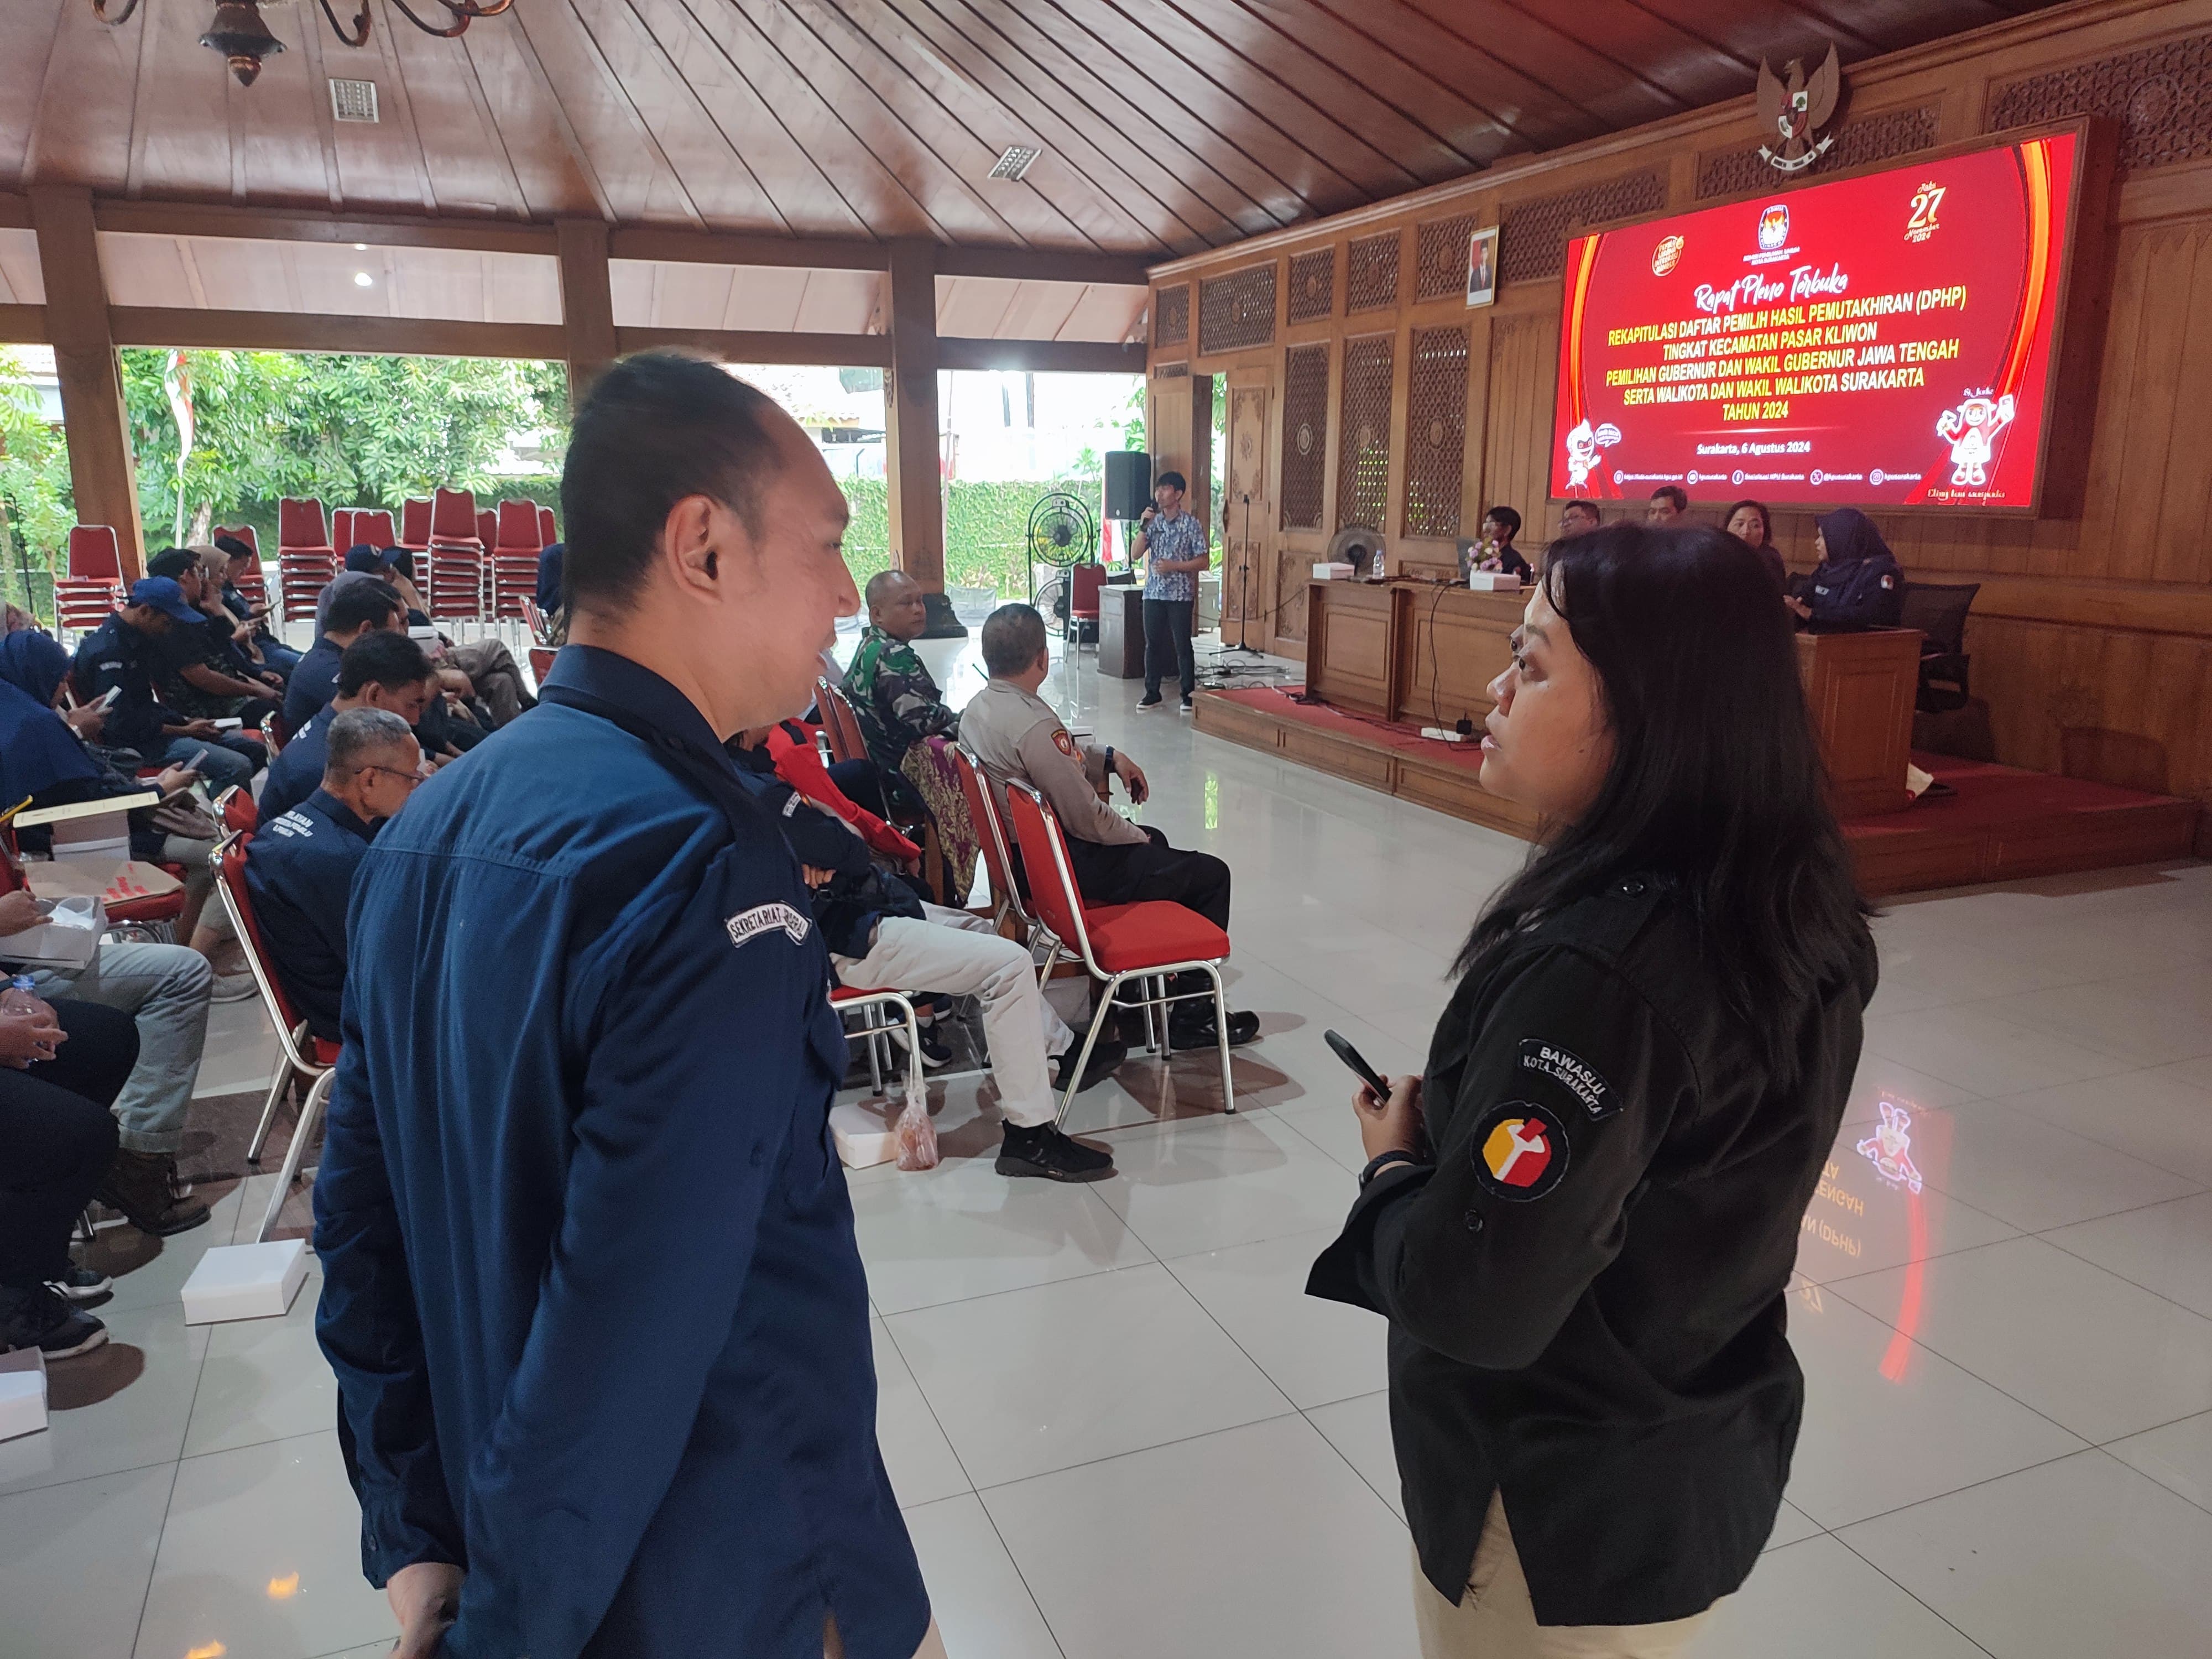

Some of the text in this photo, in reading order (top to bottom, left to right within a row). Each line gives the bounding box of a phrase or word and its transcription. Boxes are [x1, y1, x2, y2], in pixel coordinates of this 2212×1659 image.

[1907, 186, 1947, 229] 27
[1912, 231, 1932, 243] 2024
[1694, 262, 1849, 314] Rapat Pleno Terbuka
[1608, 285, 1966, 346] REKAPITULASI DAFTAR PEMILIH HASIL PEMUTAKHIRAN (DPHP)
[1663, 321, 1877, 361] TINGKAT KECAMATAN PASAR KLIWON
[1605, 338, 1960, 387] PEMILIHAN GUBERNUR DAN WAKIL GUBERNUR JAWA TENGAH
[1624, 367, 1924, 406] SERTA WALIKOTA DAN WAKIL WALIKOTA SURAKARTA
[1723, 400, 1789, 421] TAHUN 2024
[1697, 441, 1811, 456] Surakarta, 6 Agustus 2024
[729, 906, 782, 939] SEKRETARIAT
[1524, 1055, 1603, 1114] KOTA SURAKARTA
[1540, 1046, 1606, 1095] BAWASLU
